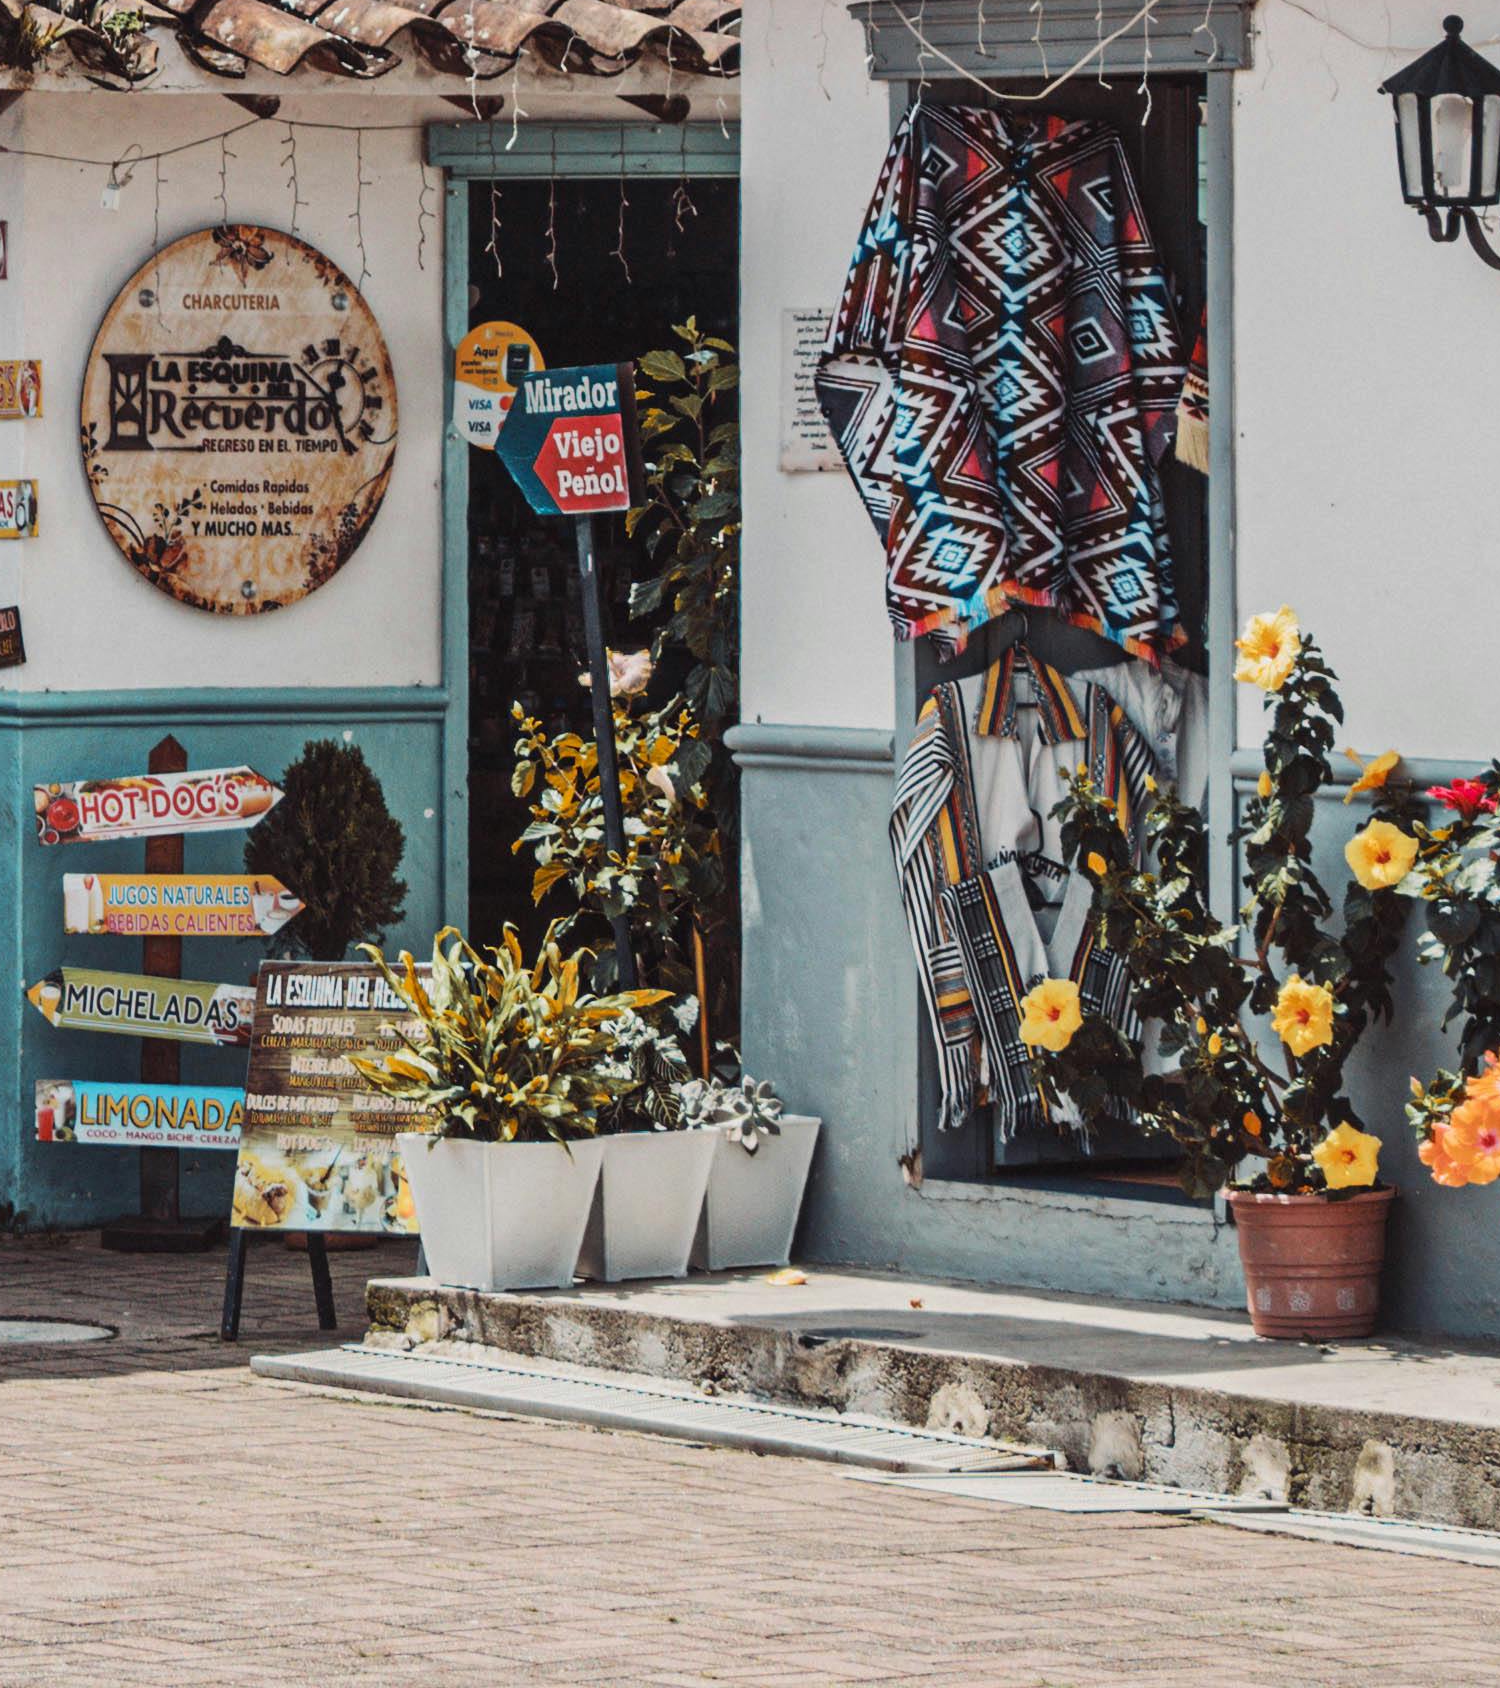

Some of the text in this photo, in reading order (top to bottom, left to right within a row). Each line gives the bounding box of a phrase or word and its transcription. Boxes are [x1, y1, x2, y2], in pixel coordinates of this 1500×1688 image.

[182, 294, 280, 311] CHARCUTERIA
[151, 360, 296, 385] LA ESQUINA
[468, 399, 492, 411] VISA
[524, 376, 618, 415] Mirador
[149, 378, 334, 440] Recuerdo
[468, 421, 492, 433] VISA
[200, 438, 339, 453] REGRESO EN EL TIEMPO
[553, 427, 620, 462] Viejo
[210, 480, 309, 495] Comidas Rapidas
[556, 464, 625, 498] Peñol
[210, 502, 313, 516] Helados Bebidas
[191, 521, 201, 536] Y
[204, 521, 257, 536] MUCHO
[80, 774, 240, 824] HOT DOG'S
[107, 885, 249, 906] JUGOS NATURALES
[107, 912, 253, 932] BEBIDAS CALIENTES
[266, 974, 282, 1006] LA
[285, 974, 343, 1008] ESQUINA
[346, 976, 370, 1008] DEL
[66, 983, 239, 1030] MICHELADAS
[271, 1014, 305, 1035] SODAS
[305, 1015, 356, 1036] FRUTALES
[126, 1131, 164, 1141] MANGO
[167, 1133, 195, 1143] BICHE
